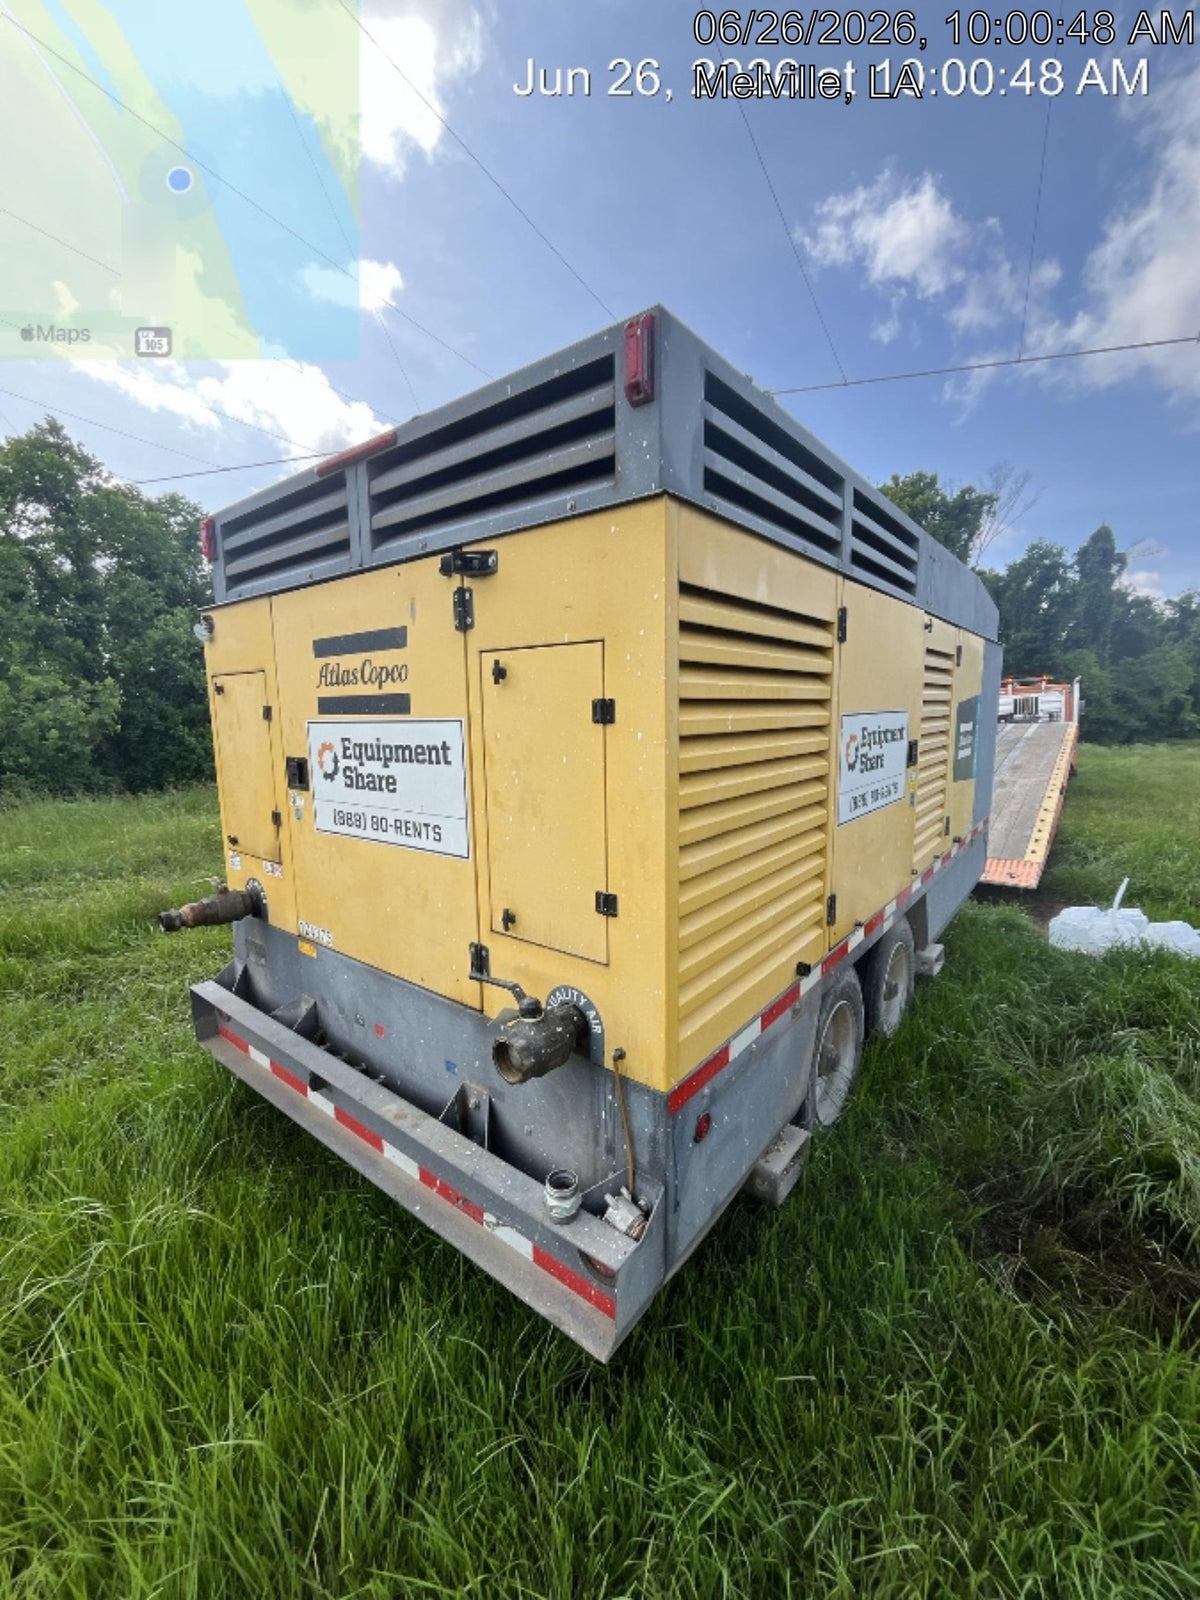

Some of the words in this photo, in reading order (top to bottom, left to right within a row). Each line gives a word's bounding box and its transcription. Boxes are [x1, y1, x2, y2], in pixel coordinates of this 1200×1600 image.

[316, 662, 358, 688] Atlas
[360, 659, 408, 690] Copco
[341, 737, 452, 768] Equipment
[342, 766, 397, 793] Share
[371, 815, 442, 842] 80-RENTS
[547, 988, 588, 1010] UALITY
